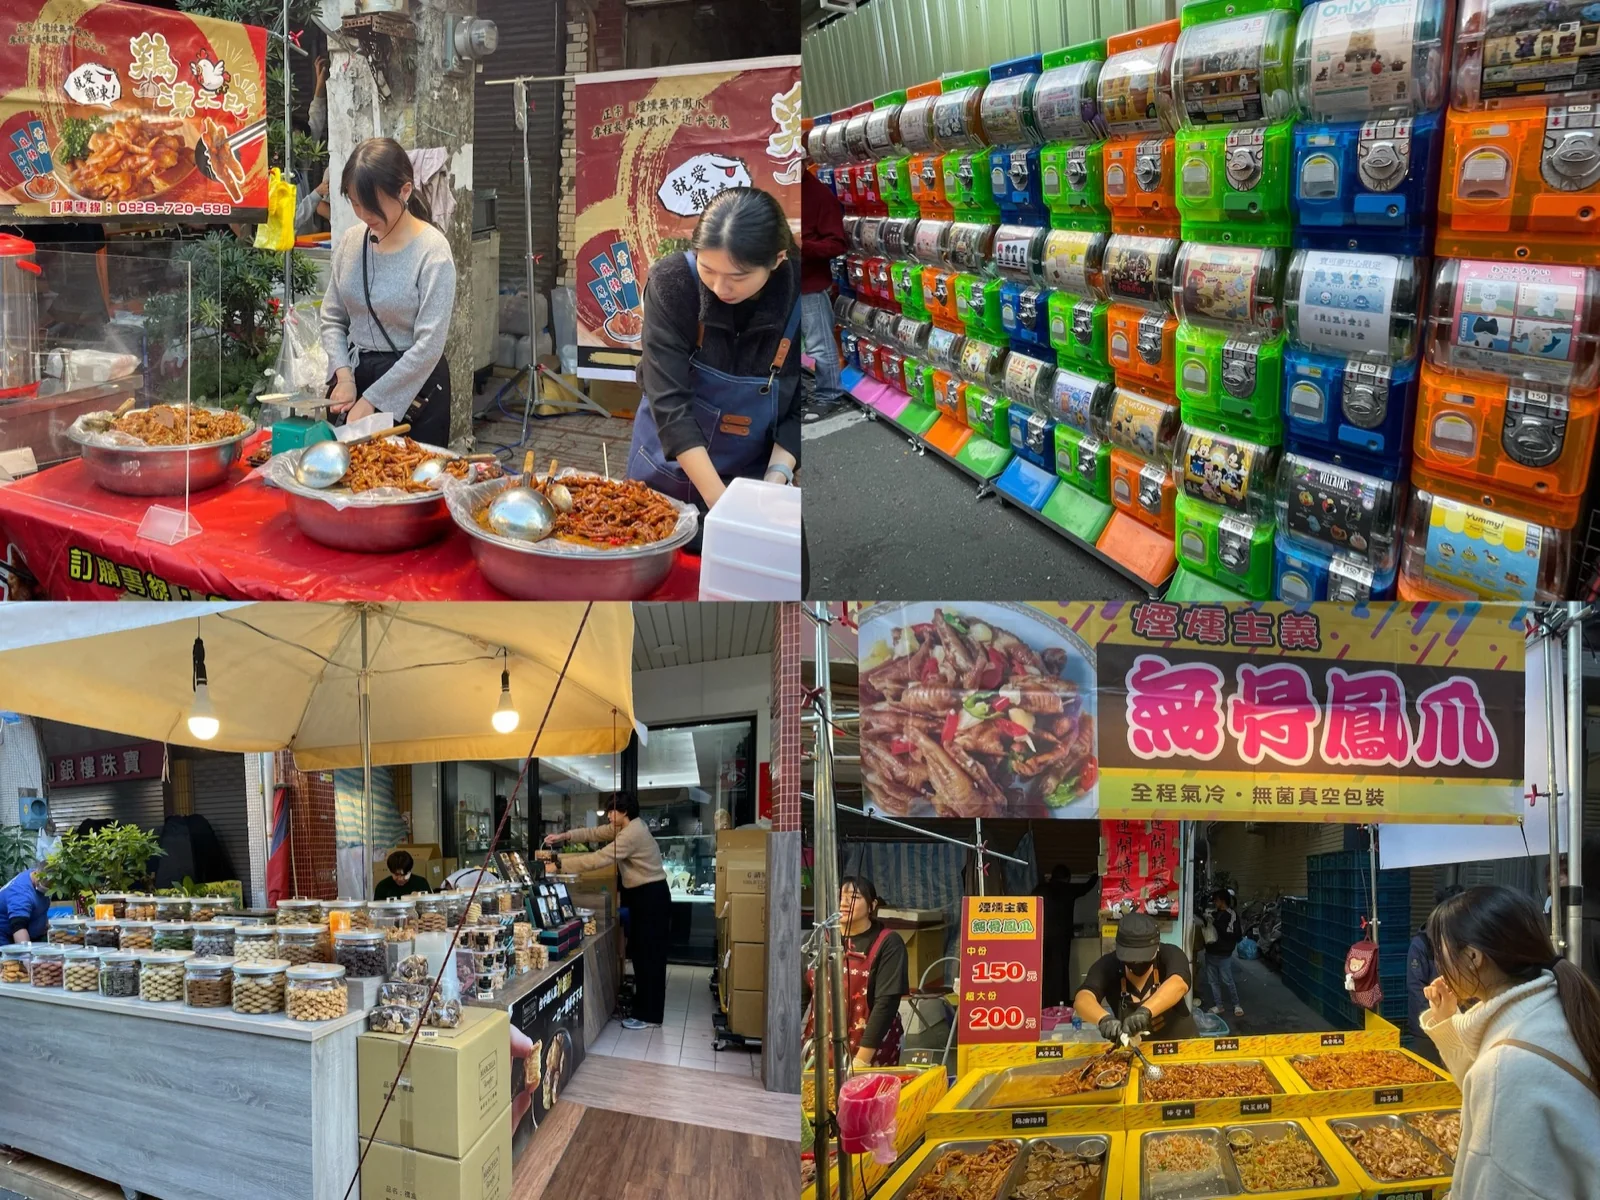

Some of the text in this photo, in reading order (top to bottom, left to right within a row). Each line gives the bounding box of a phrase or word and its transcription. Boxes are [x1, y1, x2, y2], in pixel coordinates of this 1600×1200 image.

[73, 70, 95, 91] 就愛
[672, 164, 710, 197] 就愛
[117, 202, 231, 214] 0926-720-598
[1531, 392, 1547, 401] 150
[1320, 471, 1350, 492] VILLAINS
[1465, 511, 1505, 530] Yummy!
[1126, 655, 1499, 769] 無骨鳳爪
[966, 946, 987, 956] 中份
[972, 962, 1026, 983] 150
[970, 1006, 1024, 1029] 200
